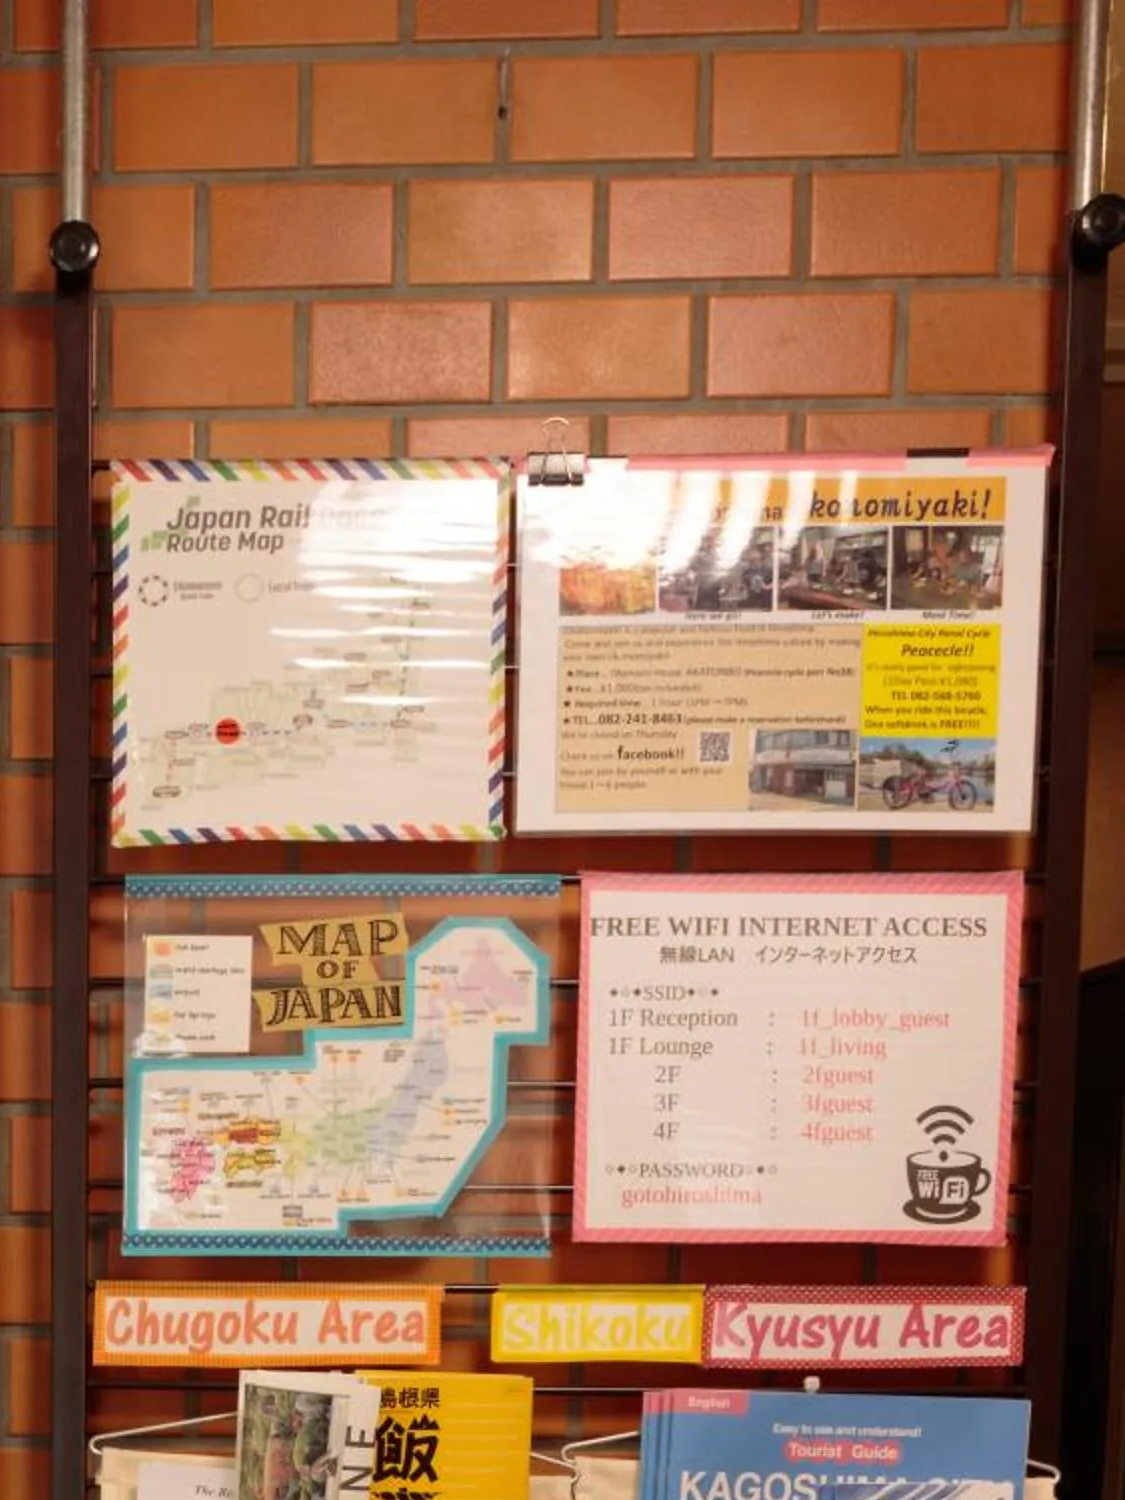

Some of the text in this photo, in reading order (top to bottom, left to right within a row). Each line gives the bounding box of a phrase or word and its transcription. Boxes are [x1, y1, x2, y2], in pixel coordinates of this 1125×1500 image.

[166, 505, 252, 532] Japan
[166, 531, 284, 555] Route Map
[277, 919, 400, 959] MAP
[590, 916, 988, 938] FREE WIFI INTERNET ACCESS
[659, 945, 918, 965] 無線LAN インターネットアクセス
[317, 959, 360, 980] OF
[266, 985, 403, 1026] JAPAN
[608, 1008, 632, 1027] 1F
[639, 1008, 738, 1032] Reception
[608, 1037, 632, 1056] 1F
[638, 1037, 713, 1060] Lounge
[654, 1066, 874, 1089] 2F 2fguest
[654, 1093, 873, 1117] 3F 3fguest
[653, 1122, 874, 1145] 4F 4fguest
[621, 1185, 763, 1209] gotohiroshima
[105, 1296, 426, 1356] Chugoku Area
[501, 1299, 695, 1350] Shikoku
[712, 1297, 1011, 1363] Kyusyu Area
[788, 1442, 899, 1461] Tourist Guide
